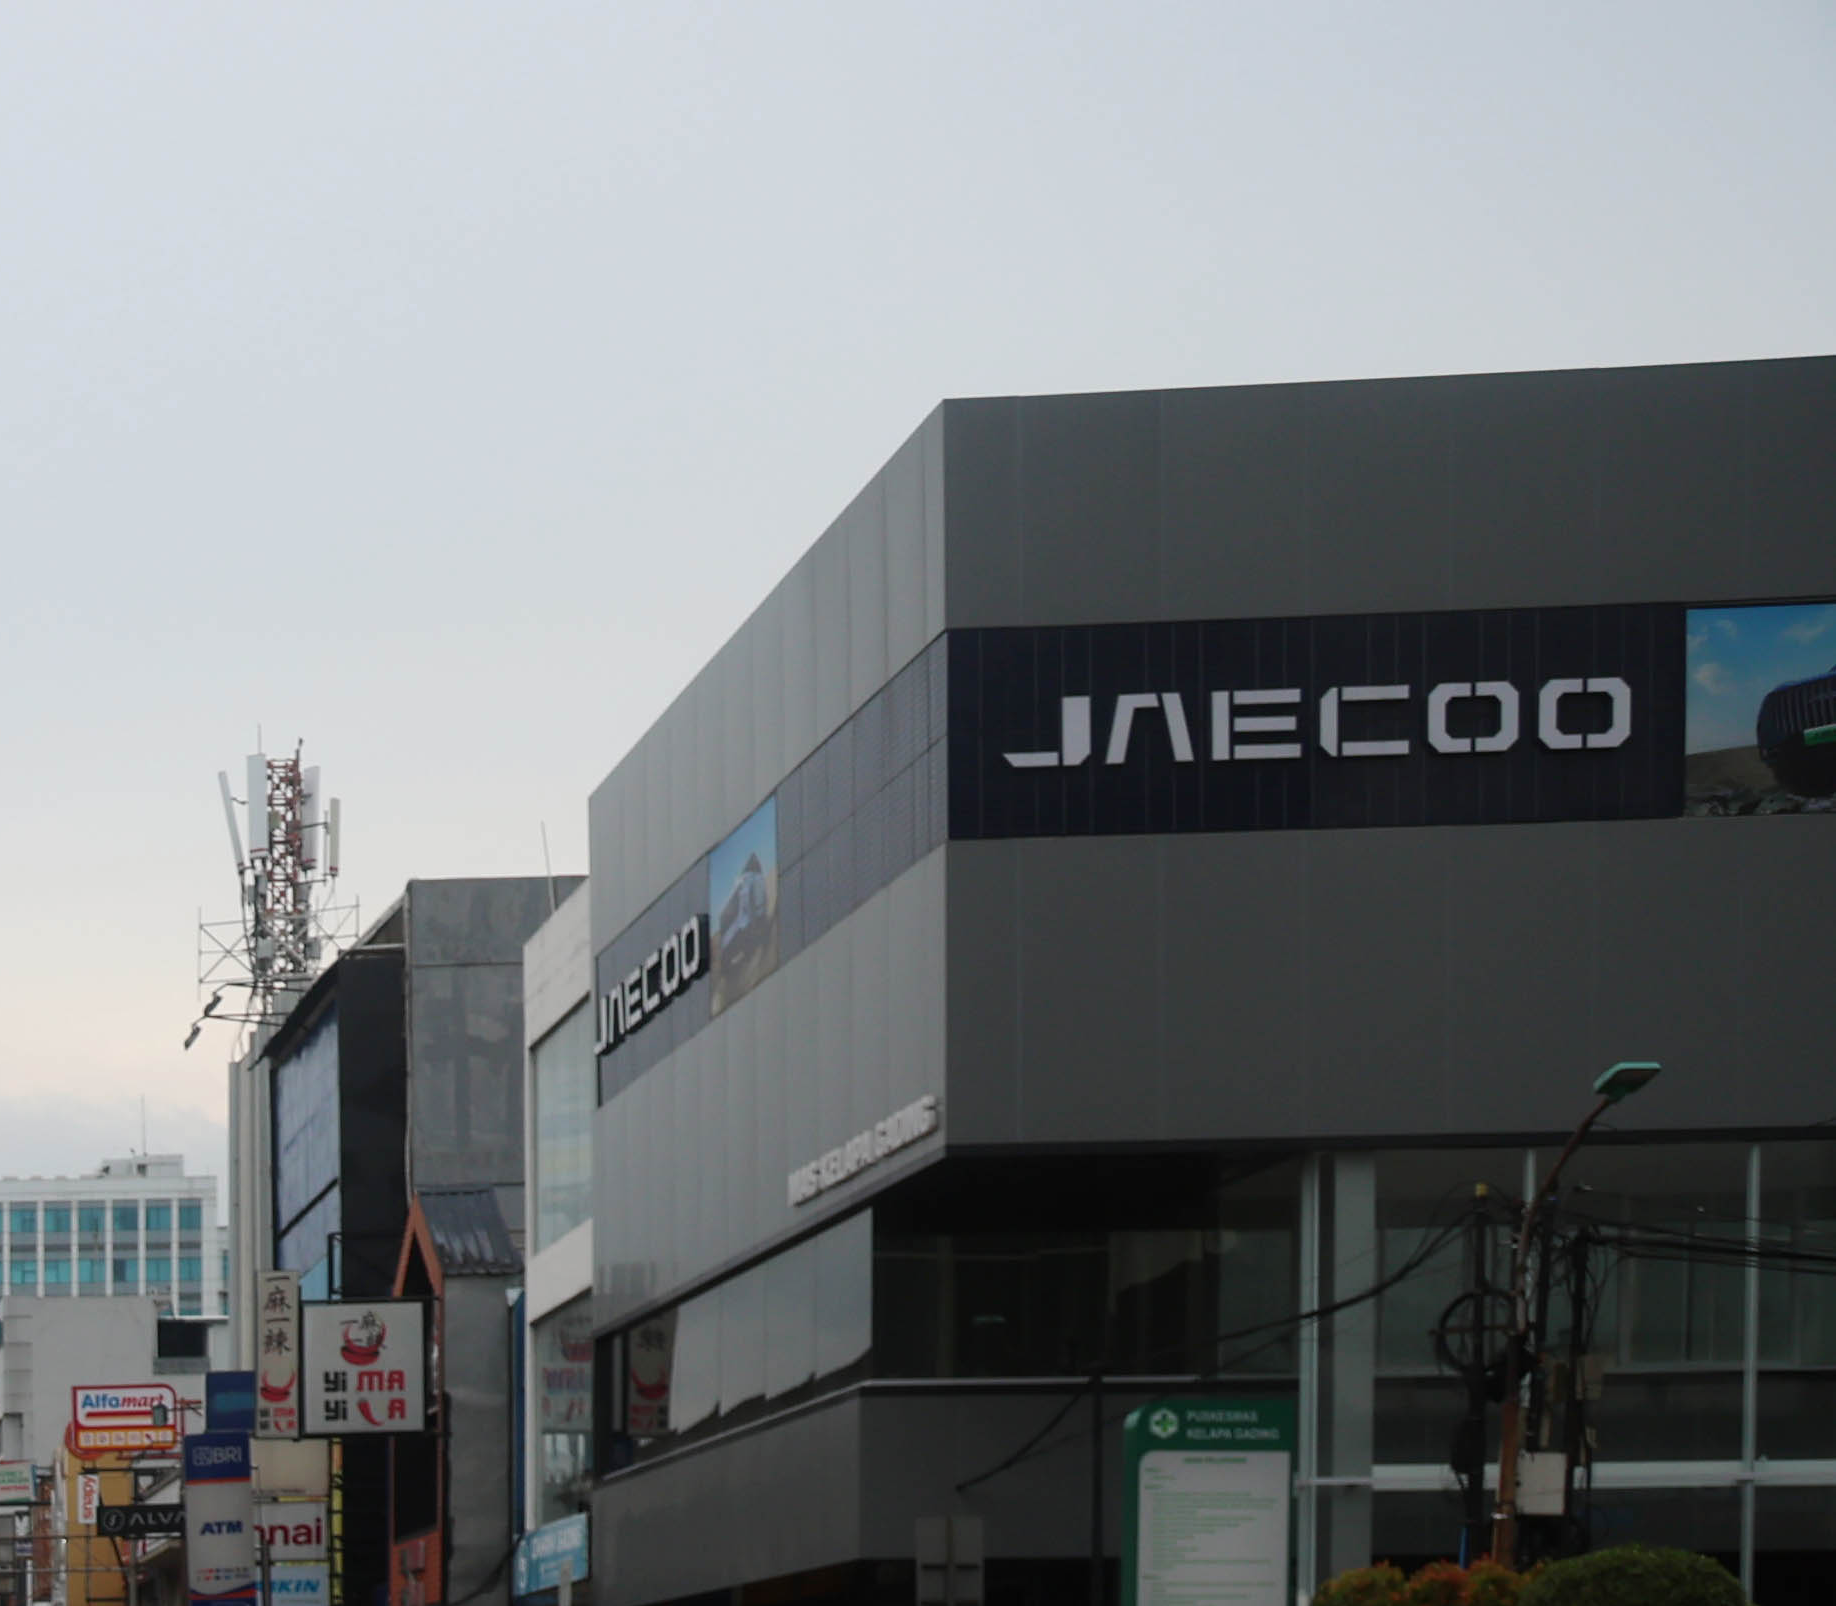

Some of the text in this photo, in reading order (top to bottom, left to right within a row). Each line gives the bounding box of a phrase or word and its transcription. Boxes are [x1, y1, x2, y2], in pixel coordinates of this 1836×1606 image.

[1003, 677, 1631, 768] JAECOO
[593, 914, 700, 1056] JAECOO
[82, 1394, 163, 1408] Alfamart
[200, 1521, 243, 1536] ATM
